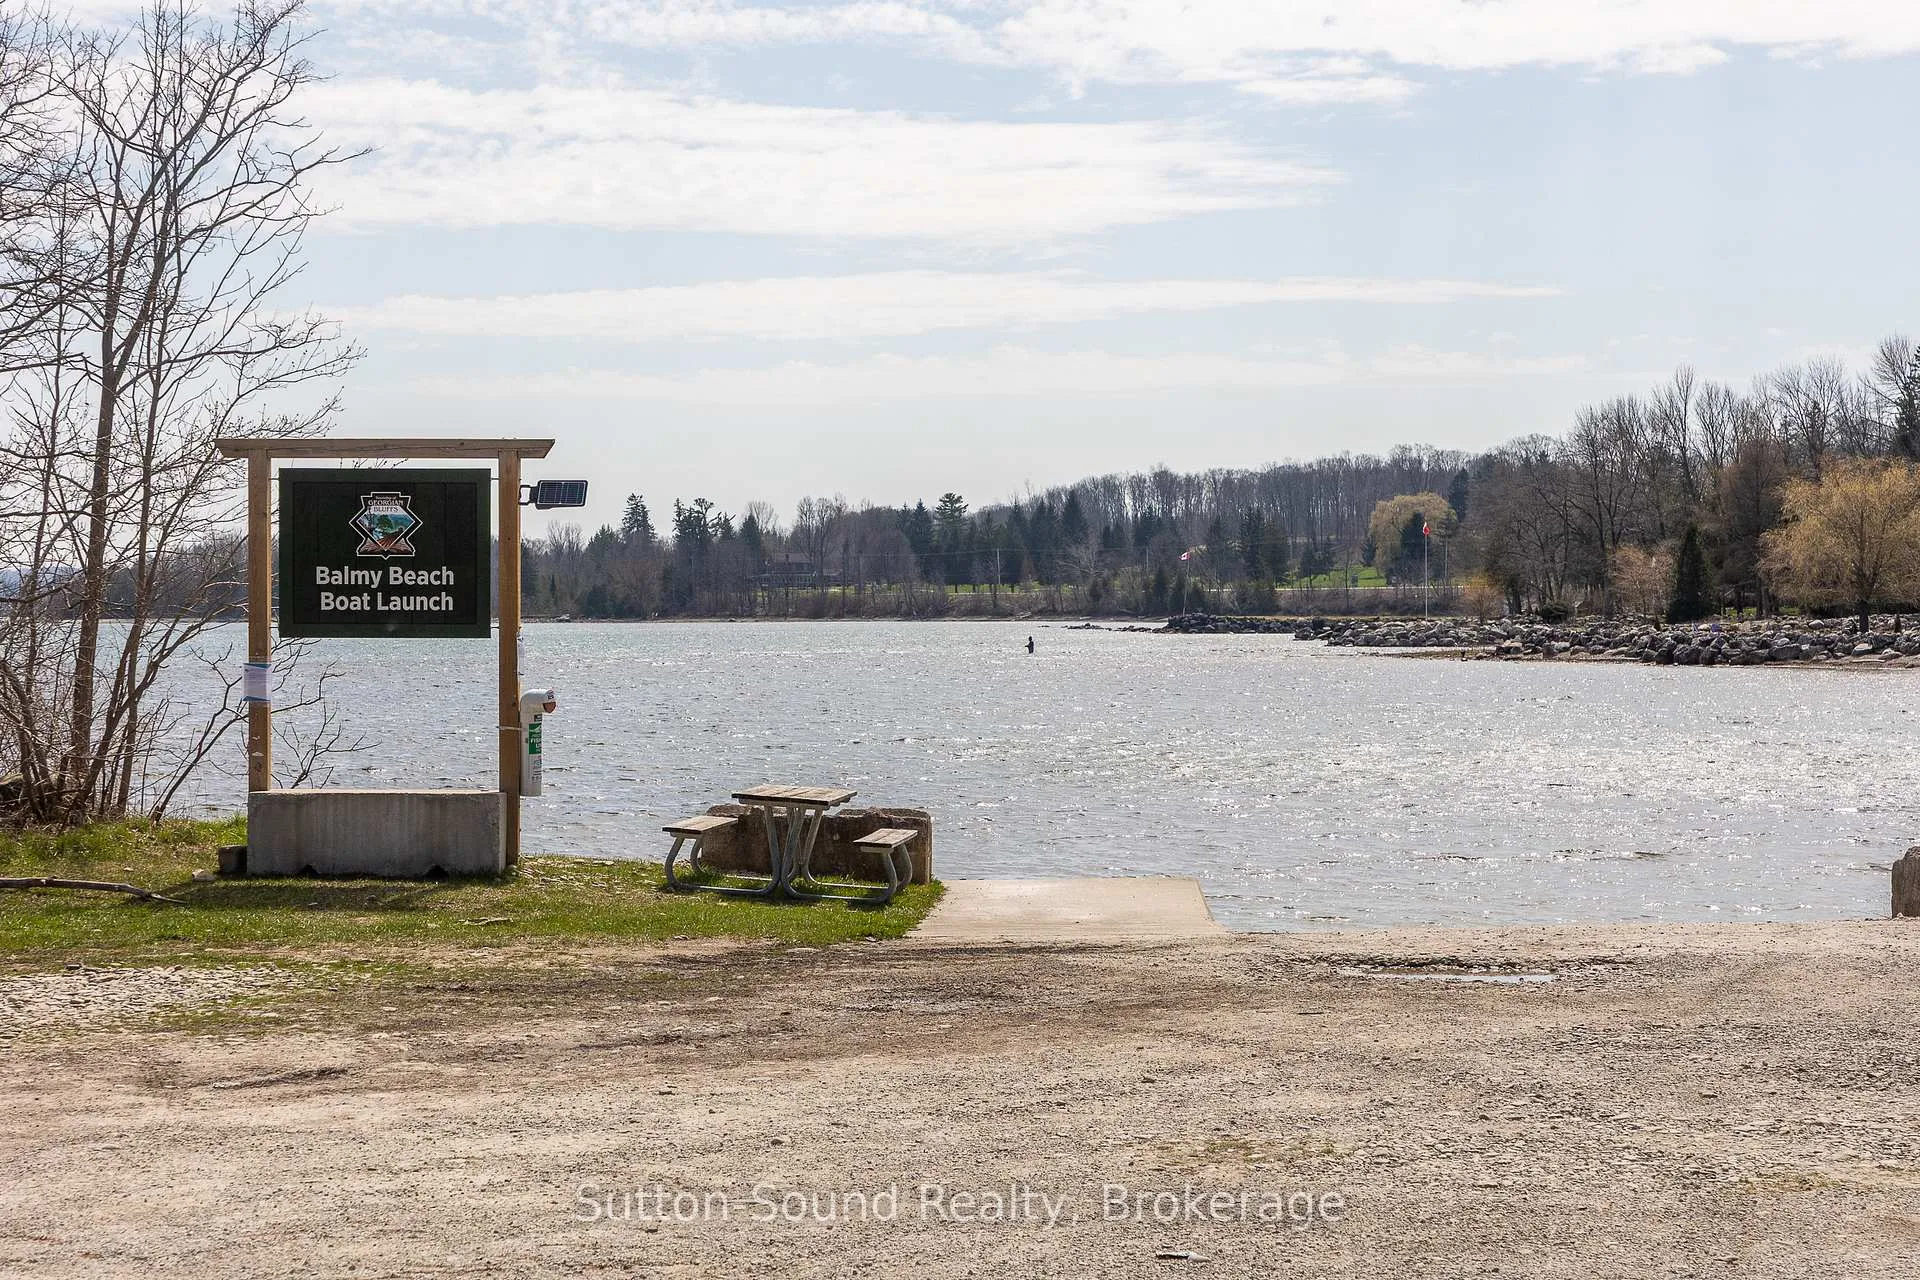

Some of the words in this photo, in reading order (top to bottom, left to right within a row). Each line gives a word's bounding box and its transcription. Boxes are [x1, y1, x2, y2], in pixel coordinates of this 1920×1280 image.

[316, 566, 383, 588] Balmy
[389, 566, 455, 585] Beach
[320, 592, 371, 611] Boat
[377, 592, 454, 611] Launch
